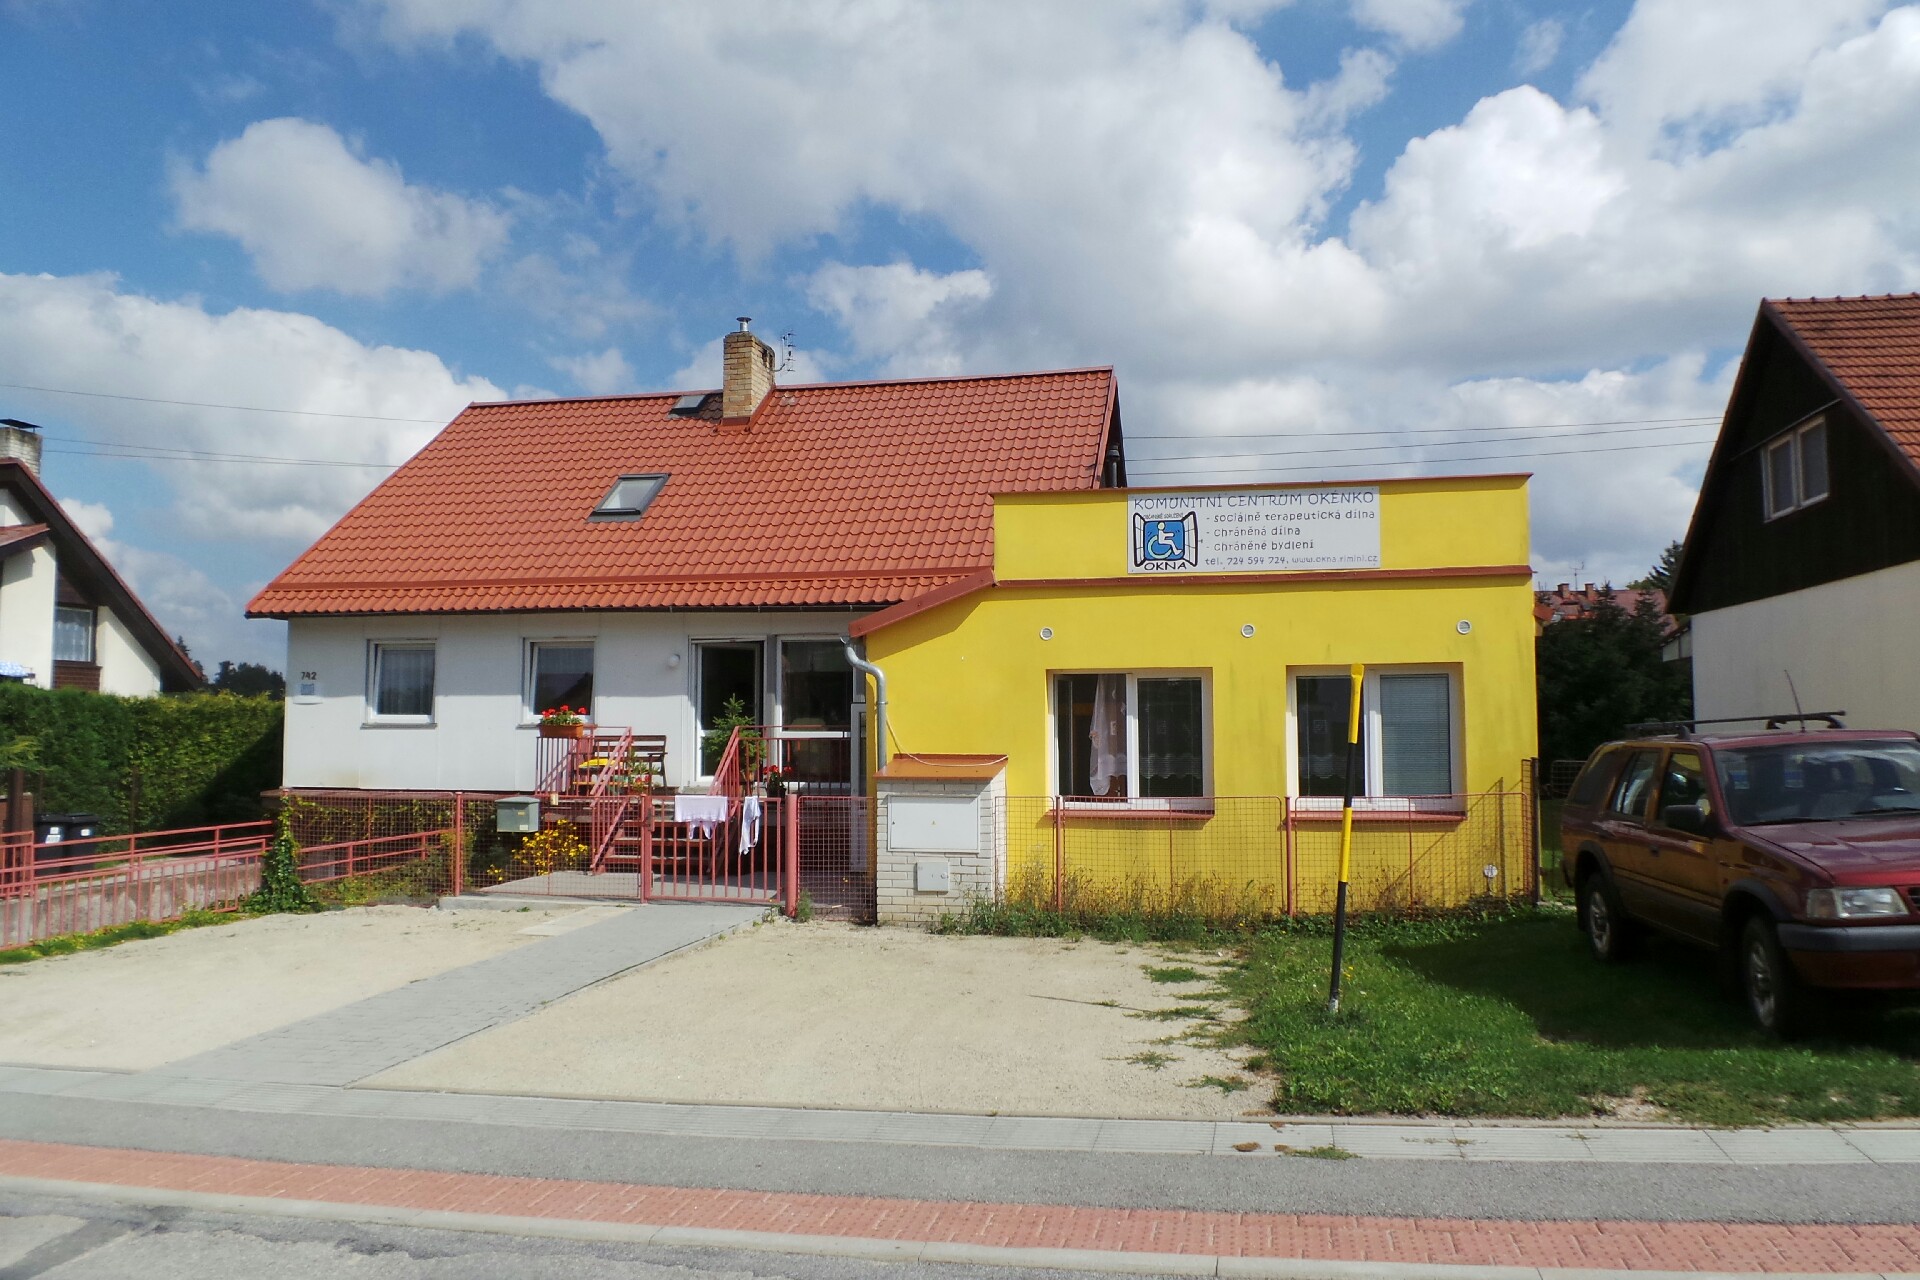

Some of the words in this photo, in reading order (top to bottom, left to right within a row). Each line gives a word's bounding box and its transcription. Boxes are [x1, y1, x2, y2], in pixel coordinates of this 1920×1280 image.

[1134, 493, 1222, 510] KOMUNITNÍ
[1227, 493, 1302, 507] CENTRUM
[1308, 490, 1374, 505] OKÉNKO
[1214, 512, 1261, 523] sociálně
[1265, 510, 1341, 522] terapeutická
[1345, 509, 1375, 519] dílna
[1214, 526, 1267, 537] chráněná
[1271, 525, 1301, 536] dílna
[1214, 540, 1267, 552] chráněné
[1271, 539, 1314, 551] bydlení
[1144, 562, 1187, 571] OKNA
[1205, 557, 1223, 566] tel.
[1227, 557, 1244, 566] 724
[1247, 556, 1265, 565] 594
[300, 671, 317, 681] 742
